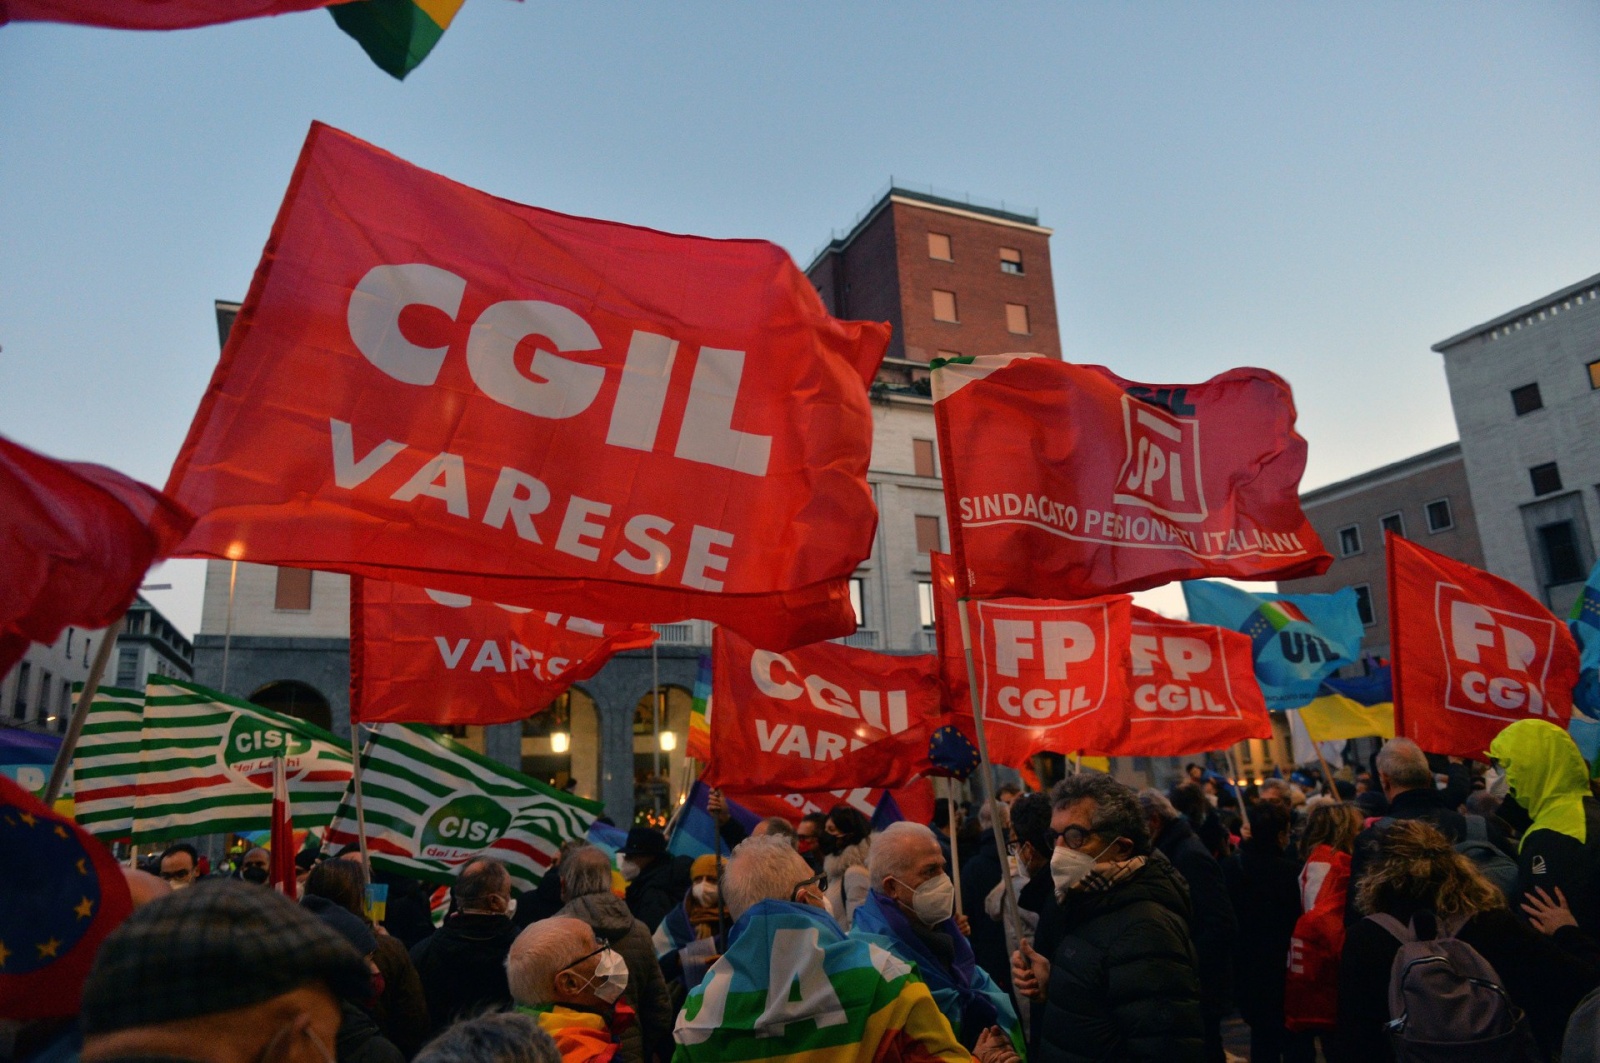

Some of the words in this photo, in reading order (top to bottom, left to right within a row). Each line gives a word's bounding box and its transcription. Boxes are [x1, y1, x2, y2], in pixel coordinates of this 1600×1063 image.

[347, 263, 772, 476] CGIL
[329, 416, 735, 593] VARESE
[959, 493, 1078, 531] SINDACATO
[1203, 528, 1304, 552] ITALIANI
[993, 618, 1096, 680] FP
[1130, 634, 1212, 681] FP
[1279, 631, 1340, 664] UIL
[1451, 600, 1537, 675] FP
[997, 686, 1092, 719] CGIL
[1134, 684, 1226, 712] CGIL
[235, 730, 302, 753] CISL
[438, 816, 500, 843] CISL
